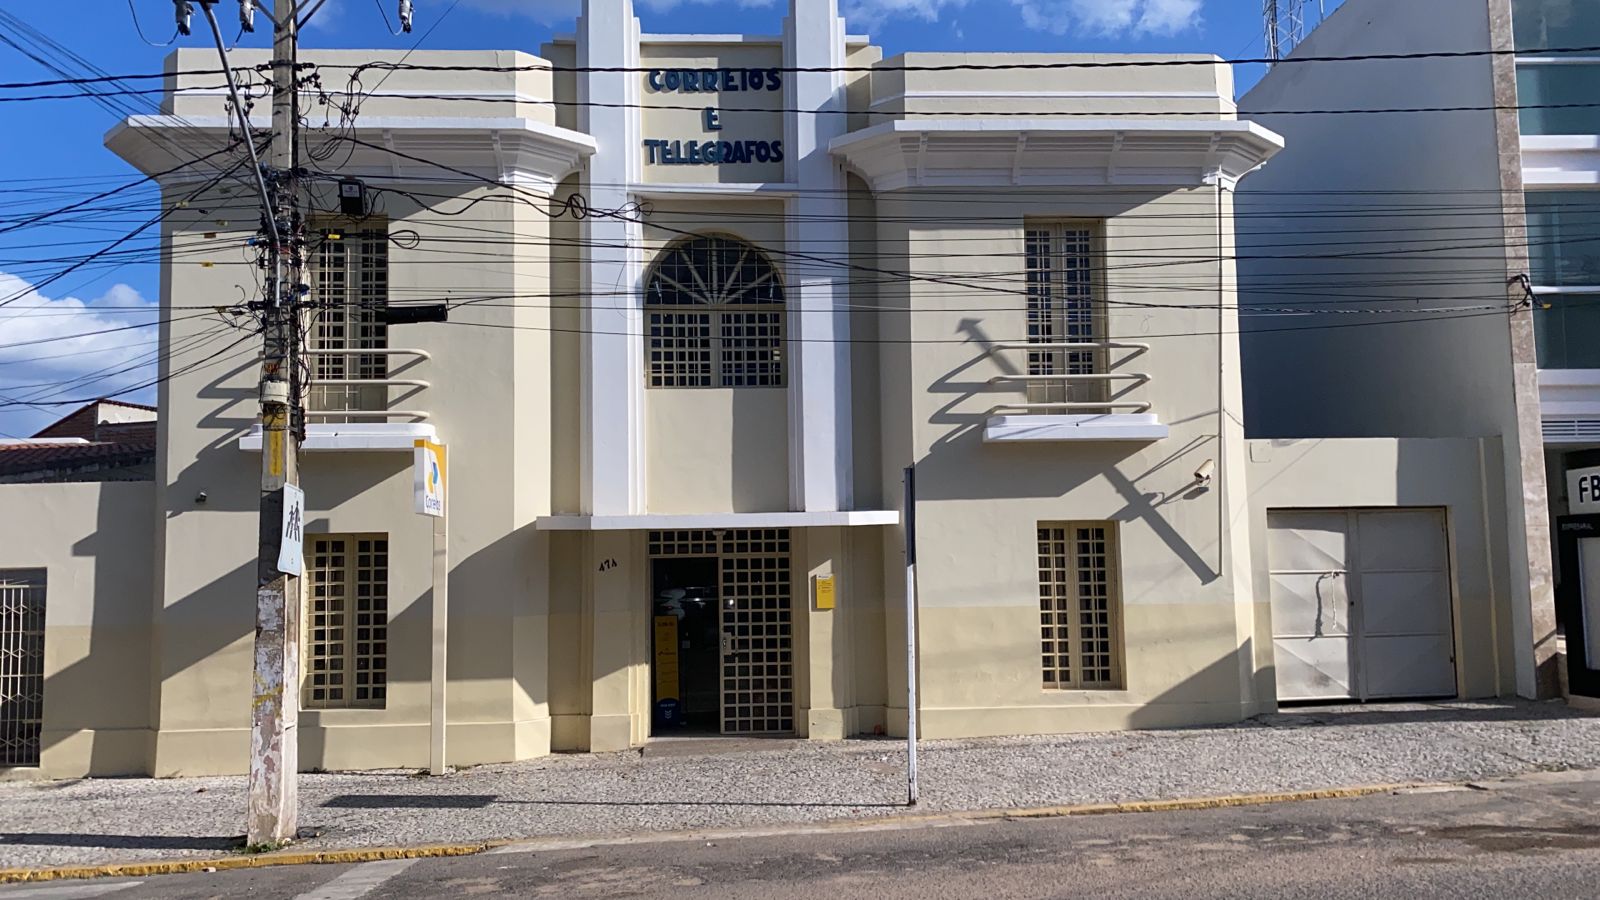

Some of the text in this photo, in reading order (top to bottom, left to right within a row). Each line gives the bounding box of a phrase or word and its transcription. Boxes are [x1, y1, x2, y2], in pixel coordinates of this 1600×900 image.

[648, 68, 782, 92] CORREIOS
[705, 107, 723, 130] E
[643, 139, 784, 164] TELEGRAFOS
